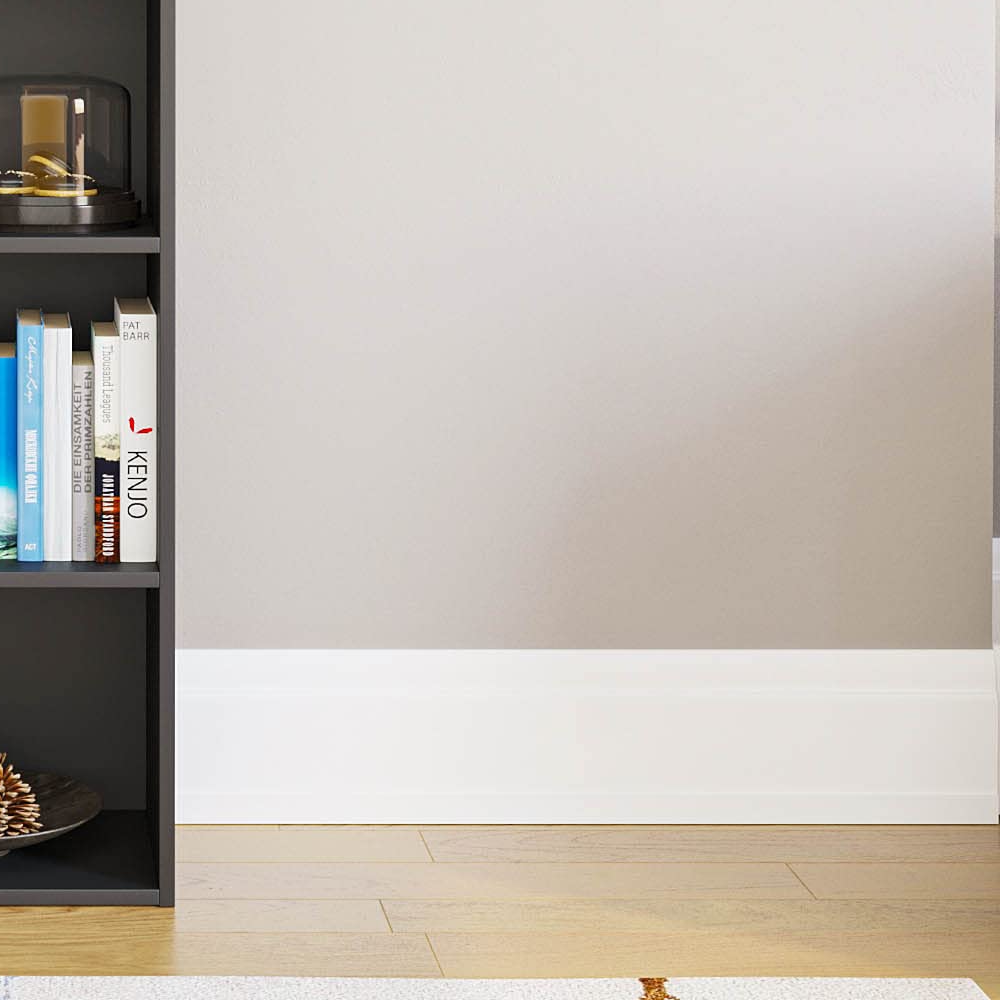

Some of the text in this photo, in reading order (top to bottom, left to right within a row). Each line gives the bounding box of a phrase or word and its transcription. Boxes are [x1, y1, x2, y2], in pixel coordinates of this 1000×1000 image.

[122, 321, 141, 330] PAT
[122, 331, 150, 341] BARR
[101, 345, 114, 424] Thousand Leagues
[73, 383, 82, 493] DIE EINSAMKEIT
[84, 371, 92, 493] DER PRIMZAHLEN
[102, 473, 115, 557] JONATHAN STANDFORD
[127, 451, 148, 520] KENJO
